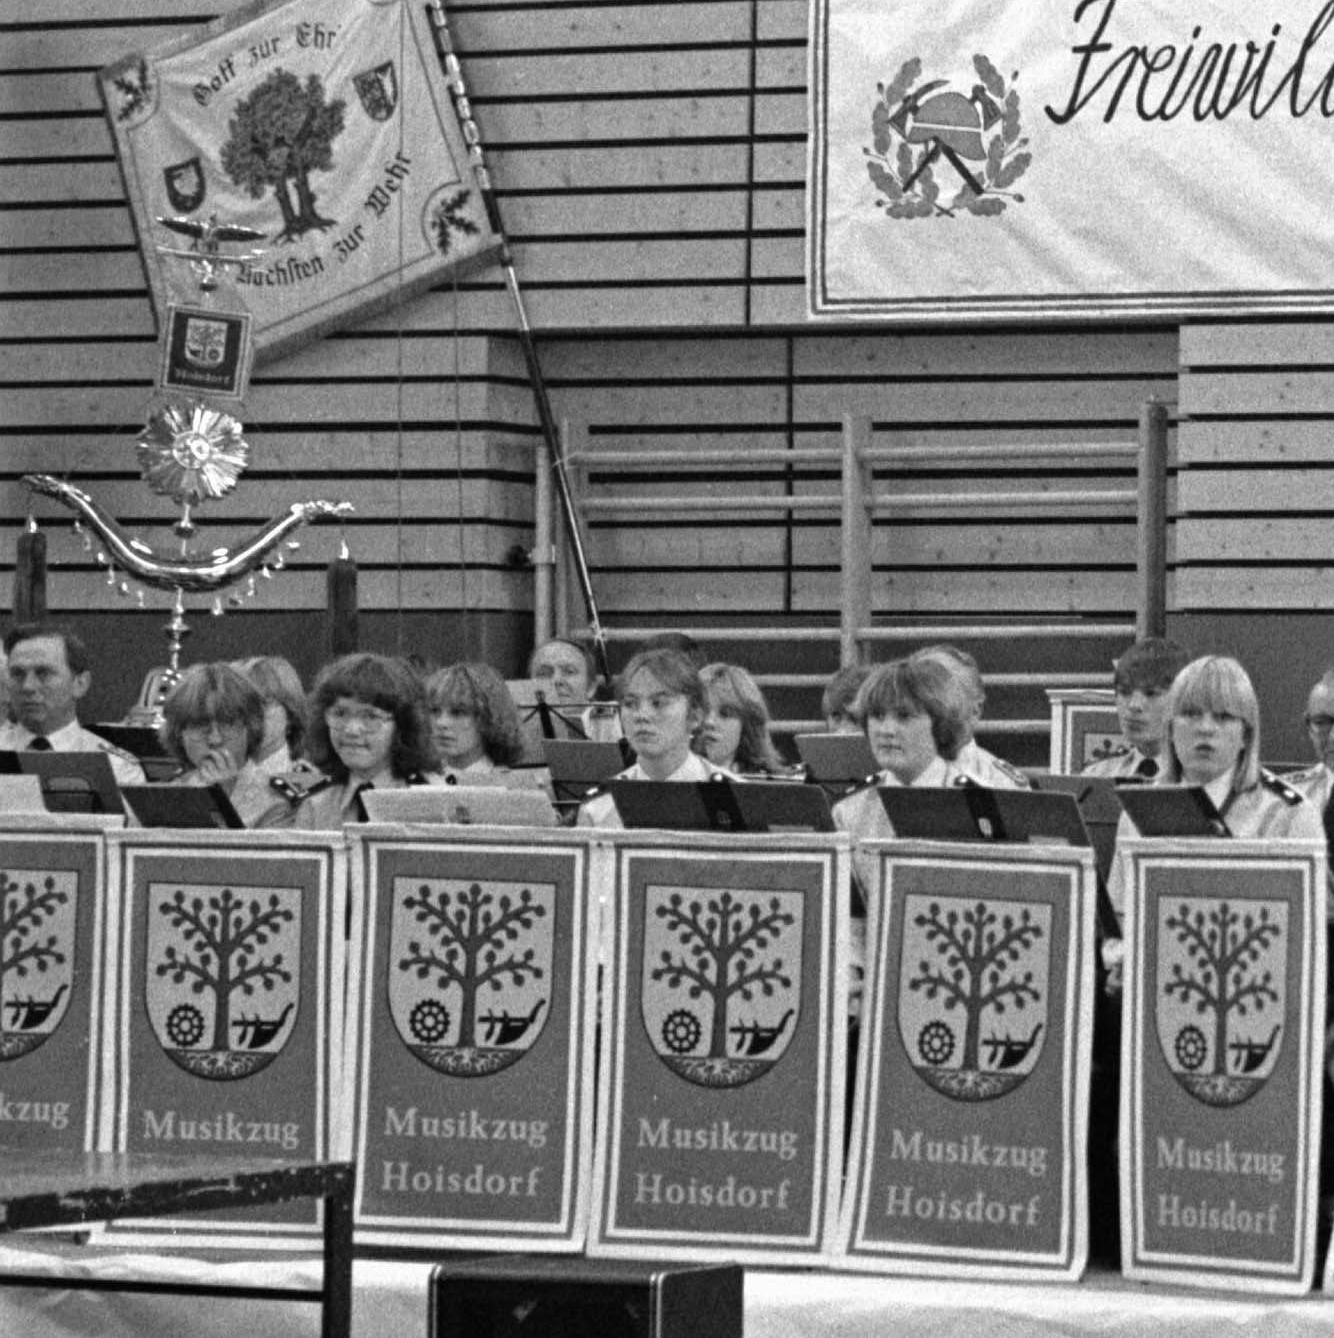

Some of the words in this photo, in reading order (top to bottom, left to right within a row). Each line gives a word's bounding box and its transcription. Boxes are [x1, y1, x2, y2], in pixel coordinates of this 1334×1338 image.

[0, 1092, 70, 1130] kzug
[142, 1109, 300, 1150] Musikzug
[383, 1106, 549, 1150] Musikzug
[637, 1117, 798, 1162] Musikzug
[889, 1128, 1048, 1177] Musikzug
[1156, 1136, 1286, 1184] Musikzug
[381, 1160, 544, 1197] Hoisdorf
[634, 1172, 791, 1210] Hoisdorf
[886, 1184, 1041, 1227] Hoisdorf
[1156, 1192, 1280, 1235] Hoisdorf
